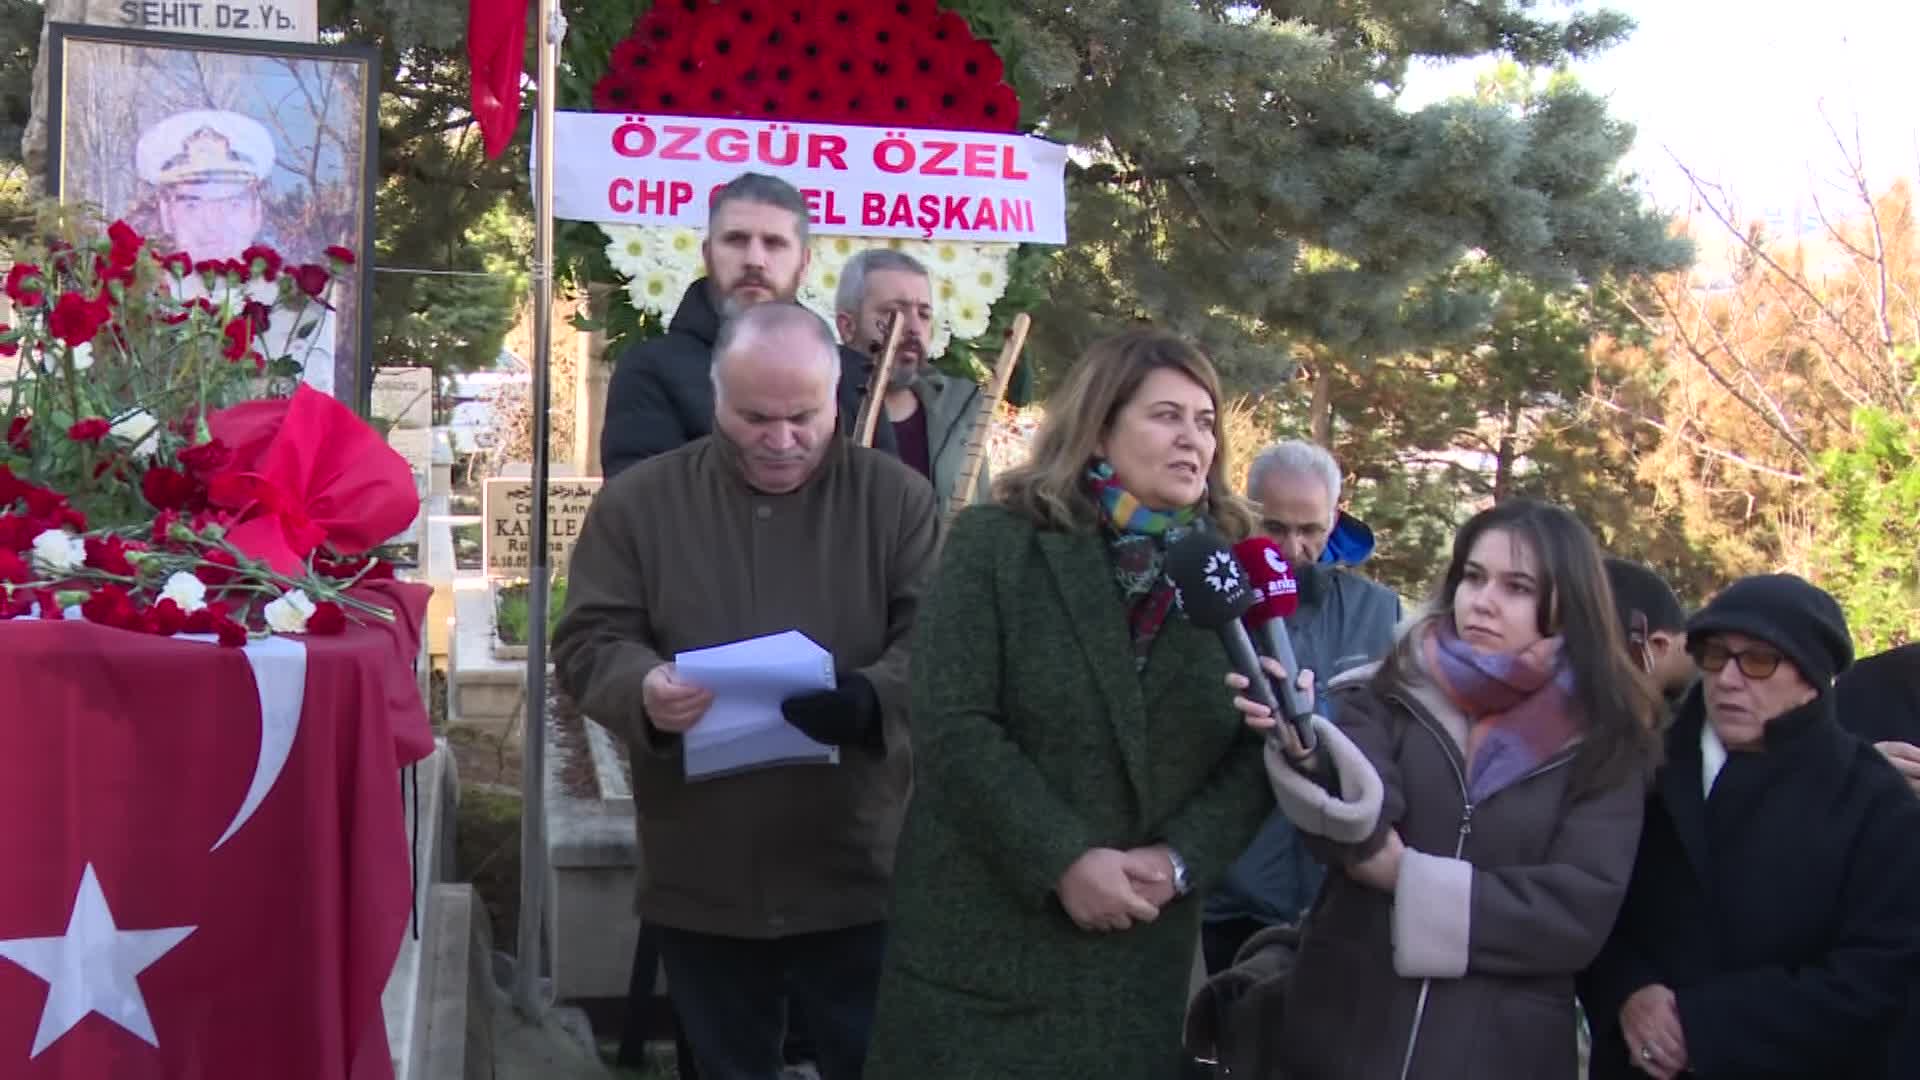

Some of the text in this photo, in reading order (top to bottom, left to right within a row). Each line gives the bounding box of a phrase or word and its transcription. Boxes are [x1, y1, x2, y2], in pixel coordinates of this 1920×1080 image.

[610, 116, 1029, 181] ÖZGÜR ÖZEL
[608, 178, 694, 217] CHP
[861, 192, 1036, 238] BAŞKANI
